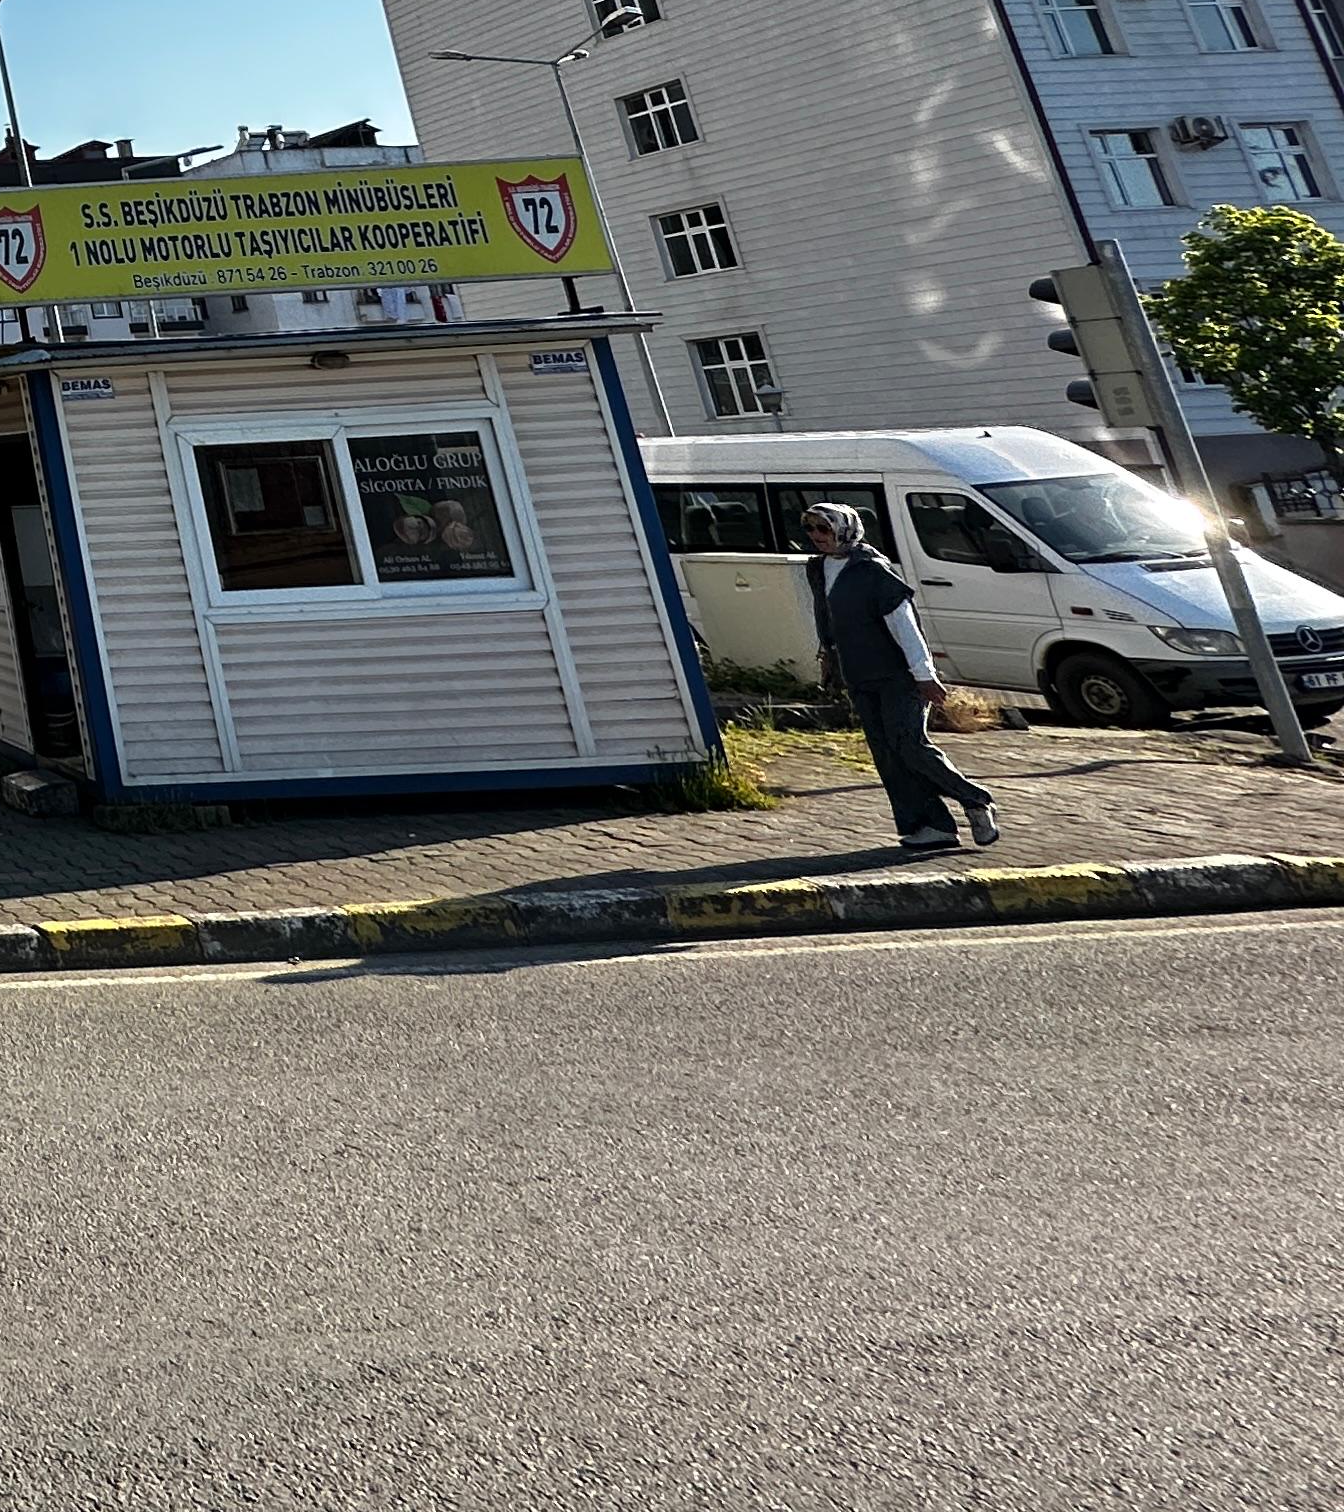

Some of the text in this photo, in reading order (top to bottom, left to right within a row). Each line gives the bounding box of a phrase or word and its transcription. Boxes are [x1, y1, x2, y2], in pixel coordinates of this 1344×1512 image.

[80, 175, 459, 229] S.S. BEŞİKDÜZÜ TRABZON MİNÜBÜSLERİ
[521, 196, 560, 235] 72
[69, 240, 81, 267] 1
[84, 237, 137, 266] NOLU
[139, 232, 232, 262] MOTORLU
[233, 226, 357, 259] TAŞIYICILAR
[356, 210, 490, 251] KOOPERATİFİ
[132, 270, 207, 291] Beşikdüzü
[267, 266, 288, 281] 26
[300, 263, 360, 280] Trabzon
[418, 258, 439, 274] 26
[353, 451, 483, 474] ALOĞLU GRUP
[360, 476, 427, 495] SİGORTA
[435, 474, 488, 489] FINDIK
